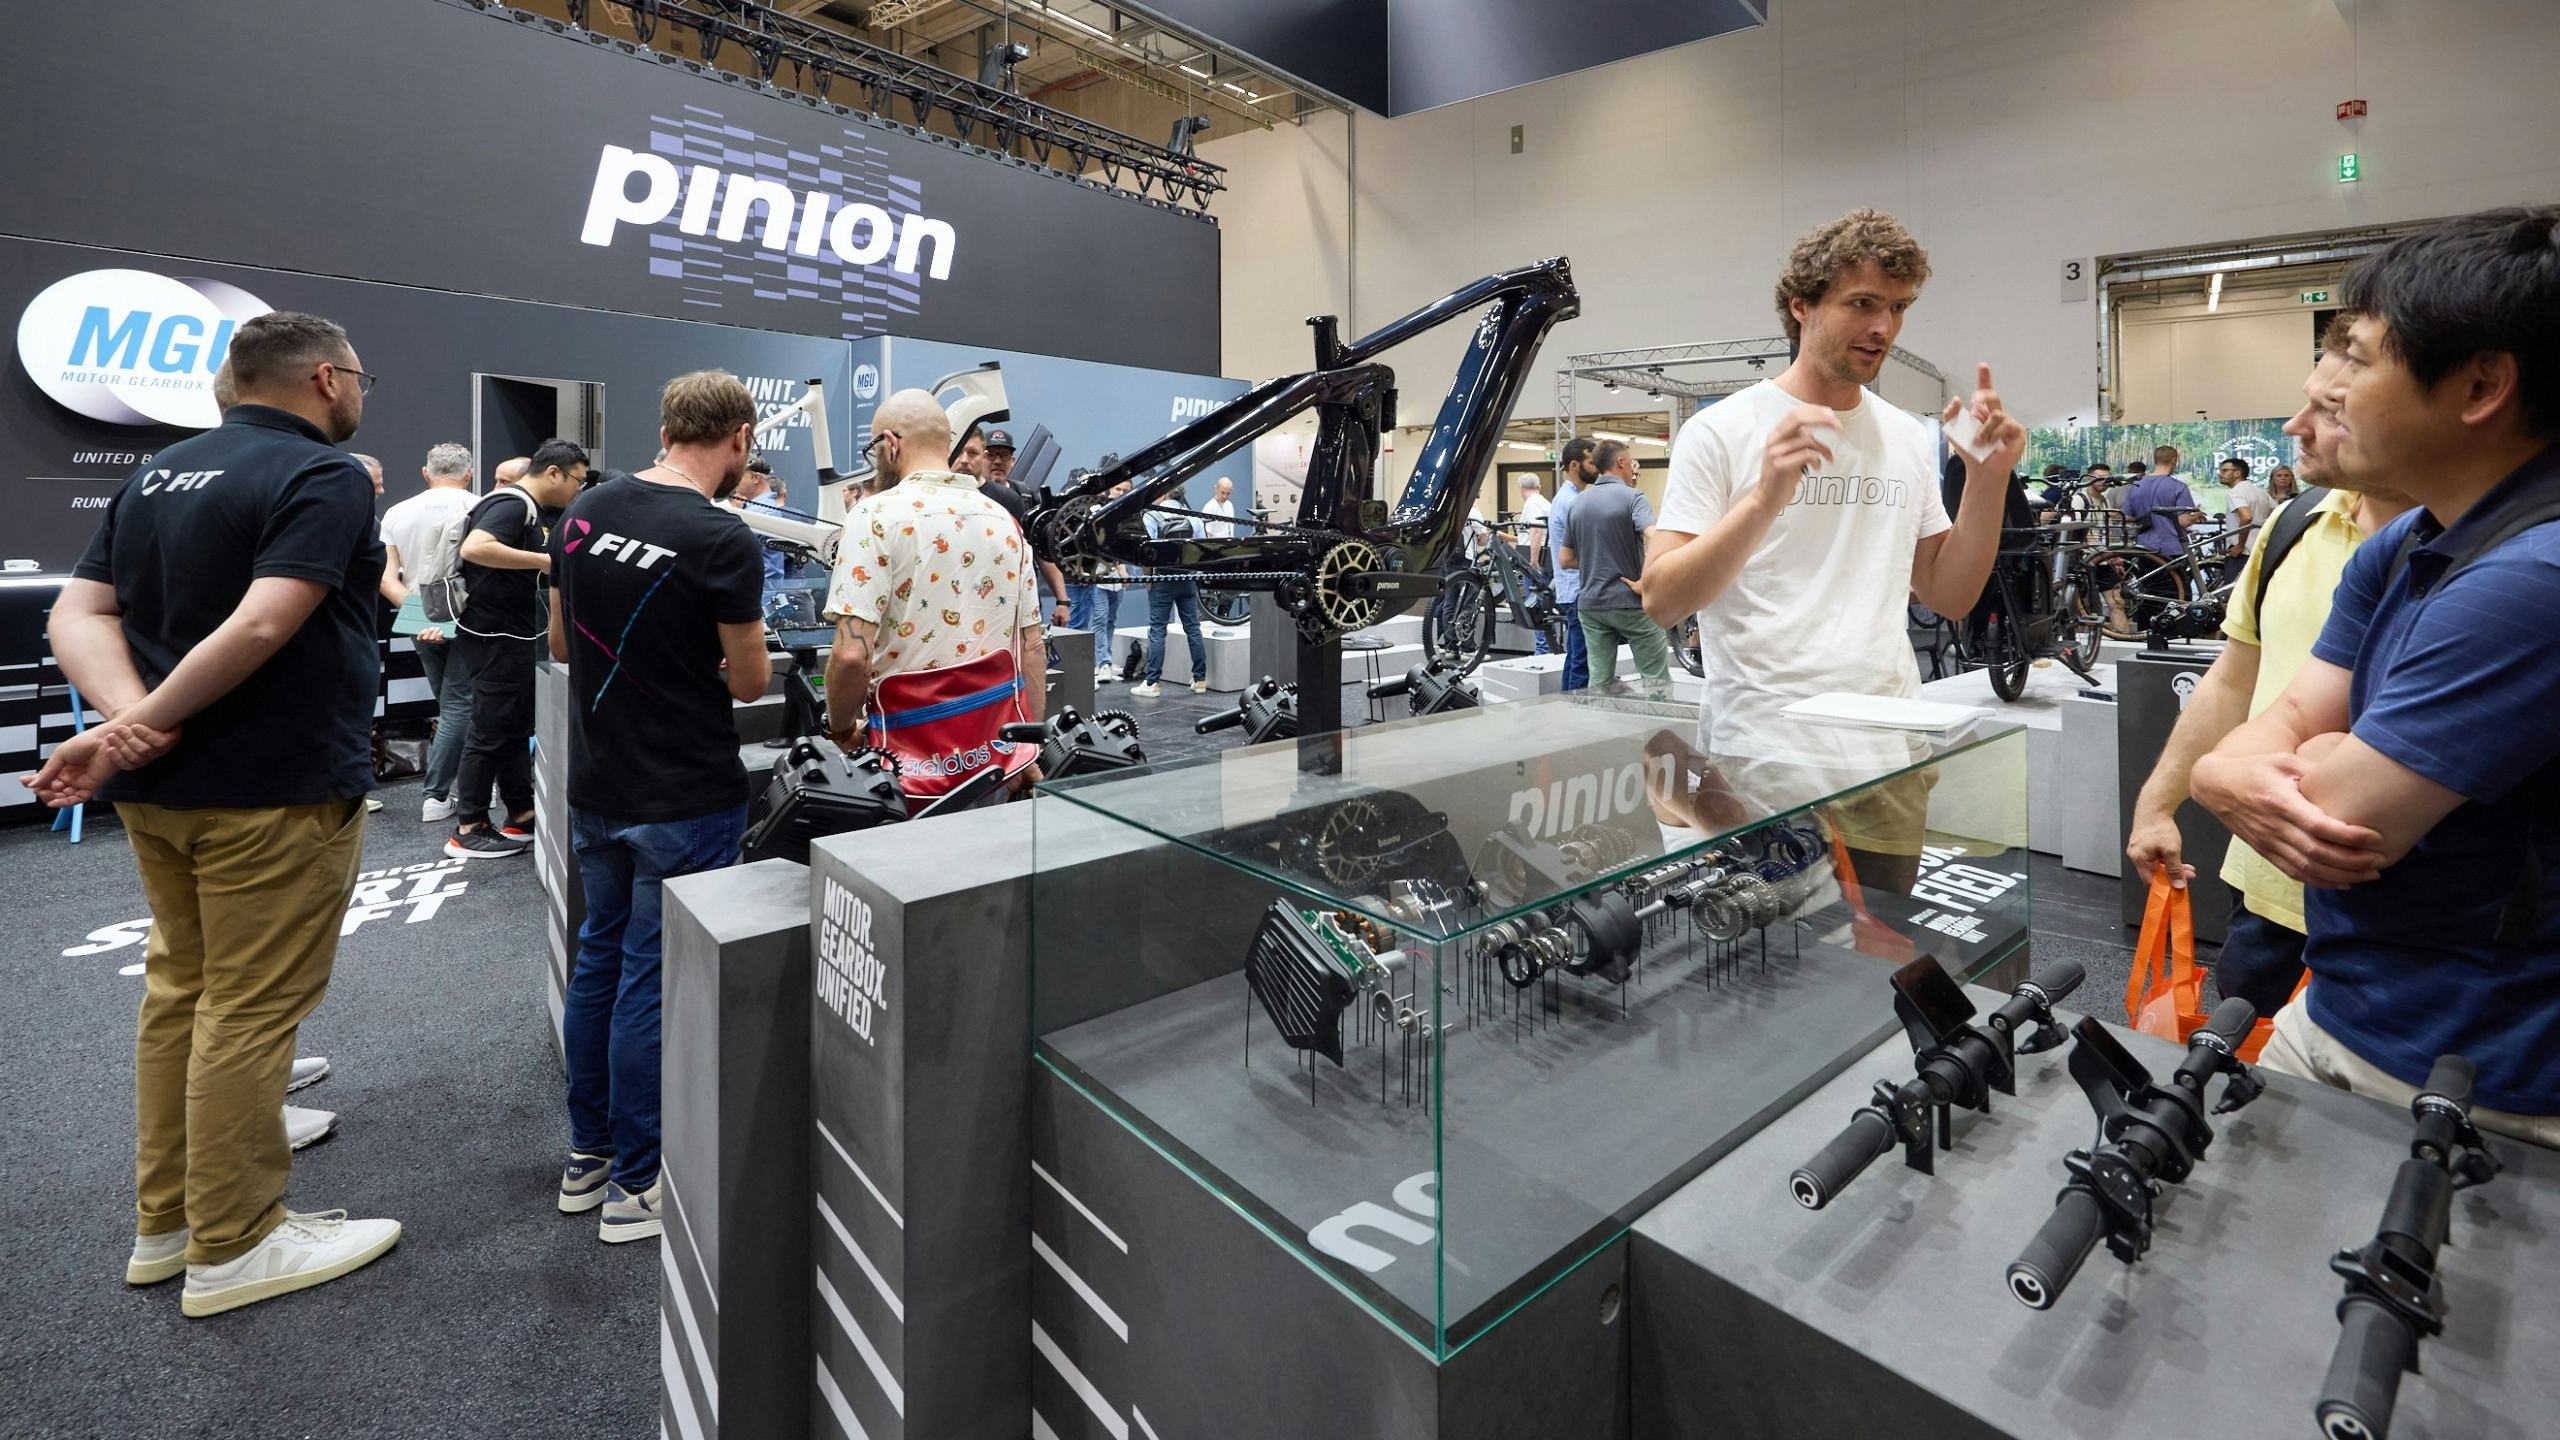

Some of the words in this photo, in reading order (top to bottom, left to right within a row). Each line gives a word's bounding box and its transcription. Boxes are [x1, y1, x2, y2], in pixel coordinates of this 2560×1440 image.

[581, 143, 956, 280] pinion
[2066, 263, 2080, 280] 3
[746, 376, 797, 402] UNIT.
[73, 452, 135, 464] UNITED
[2213, 451, 2280, 474] Plago
[165, 470, 225, 492] FIT
[589, 533, 678, 569] FIT
[1377, 582, 1400, 591] pinion
[901, 744, 991, 776] adidas
[824, 876, 875, 952] MOTOR.
[820, 918, 888, 1011] GEARBOX.
[816, 957, 875, 1047] UNIFIED.
